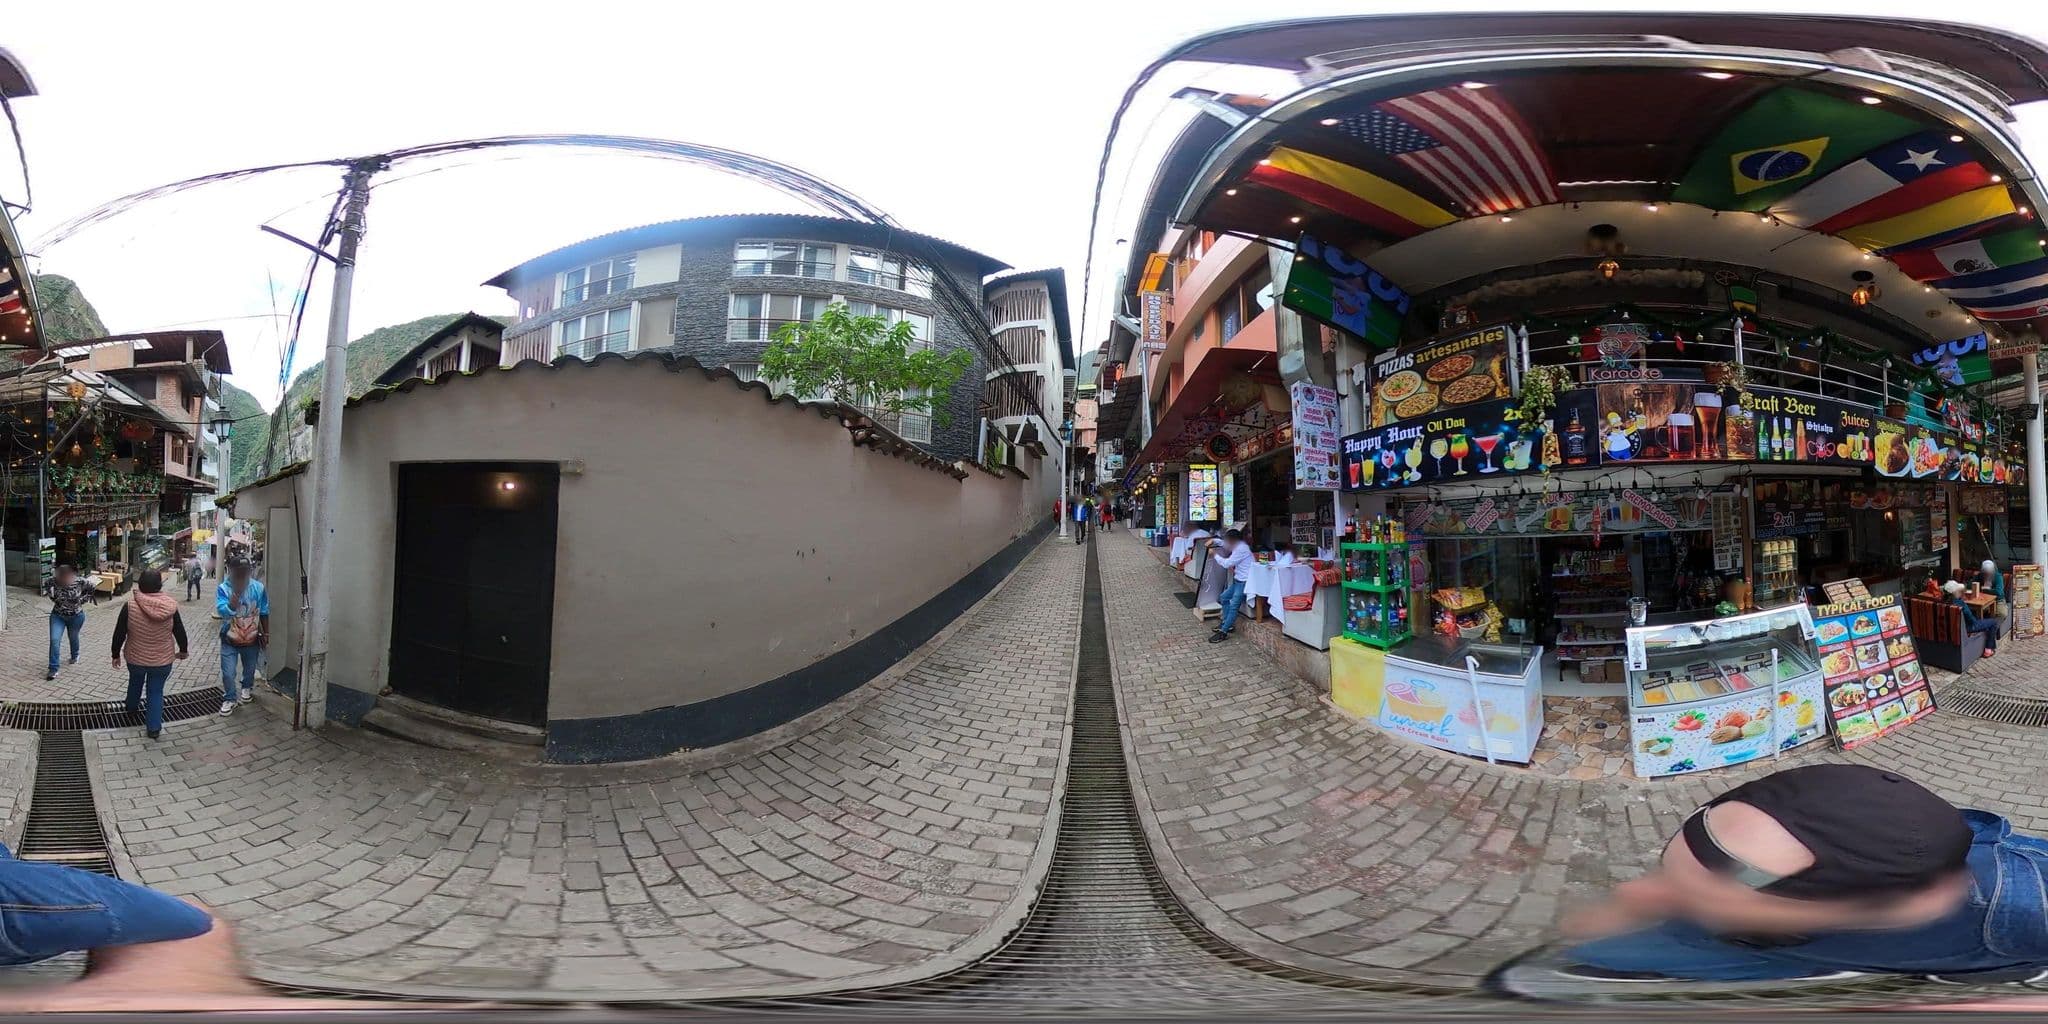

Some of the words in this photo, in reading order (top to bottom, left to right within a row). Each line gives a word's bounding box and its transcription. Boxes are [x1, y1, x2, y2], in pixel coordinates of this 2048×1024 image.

[1379, 353, 1415, 378] PIZZAS
[1416, 330, 1505, 364] artesanales
[1591, 367, 1662, 380] Karaoke
[1740, 392, 1780, 415] Craft
[1784, 396, 1817, 416] Beer
[1806, 421, 1834, 434] Shisha
[1840, 411, 1870, 428] Juices
[1345, 433, 1382, 454] Happy
[1387, 425, 1424, 444] Hour
[1445, 417, 1466, 431] Day
[1623, 490, 1677, 528] CREMOLADAS
[1773, 511, 1796, 528] 2x1
[1477, 510, 1499, 532] FRITOS
[1816, 602, 1864, 616] TYPICAL
[1866, 594, 1895, 609] FOOD
